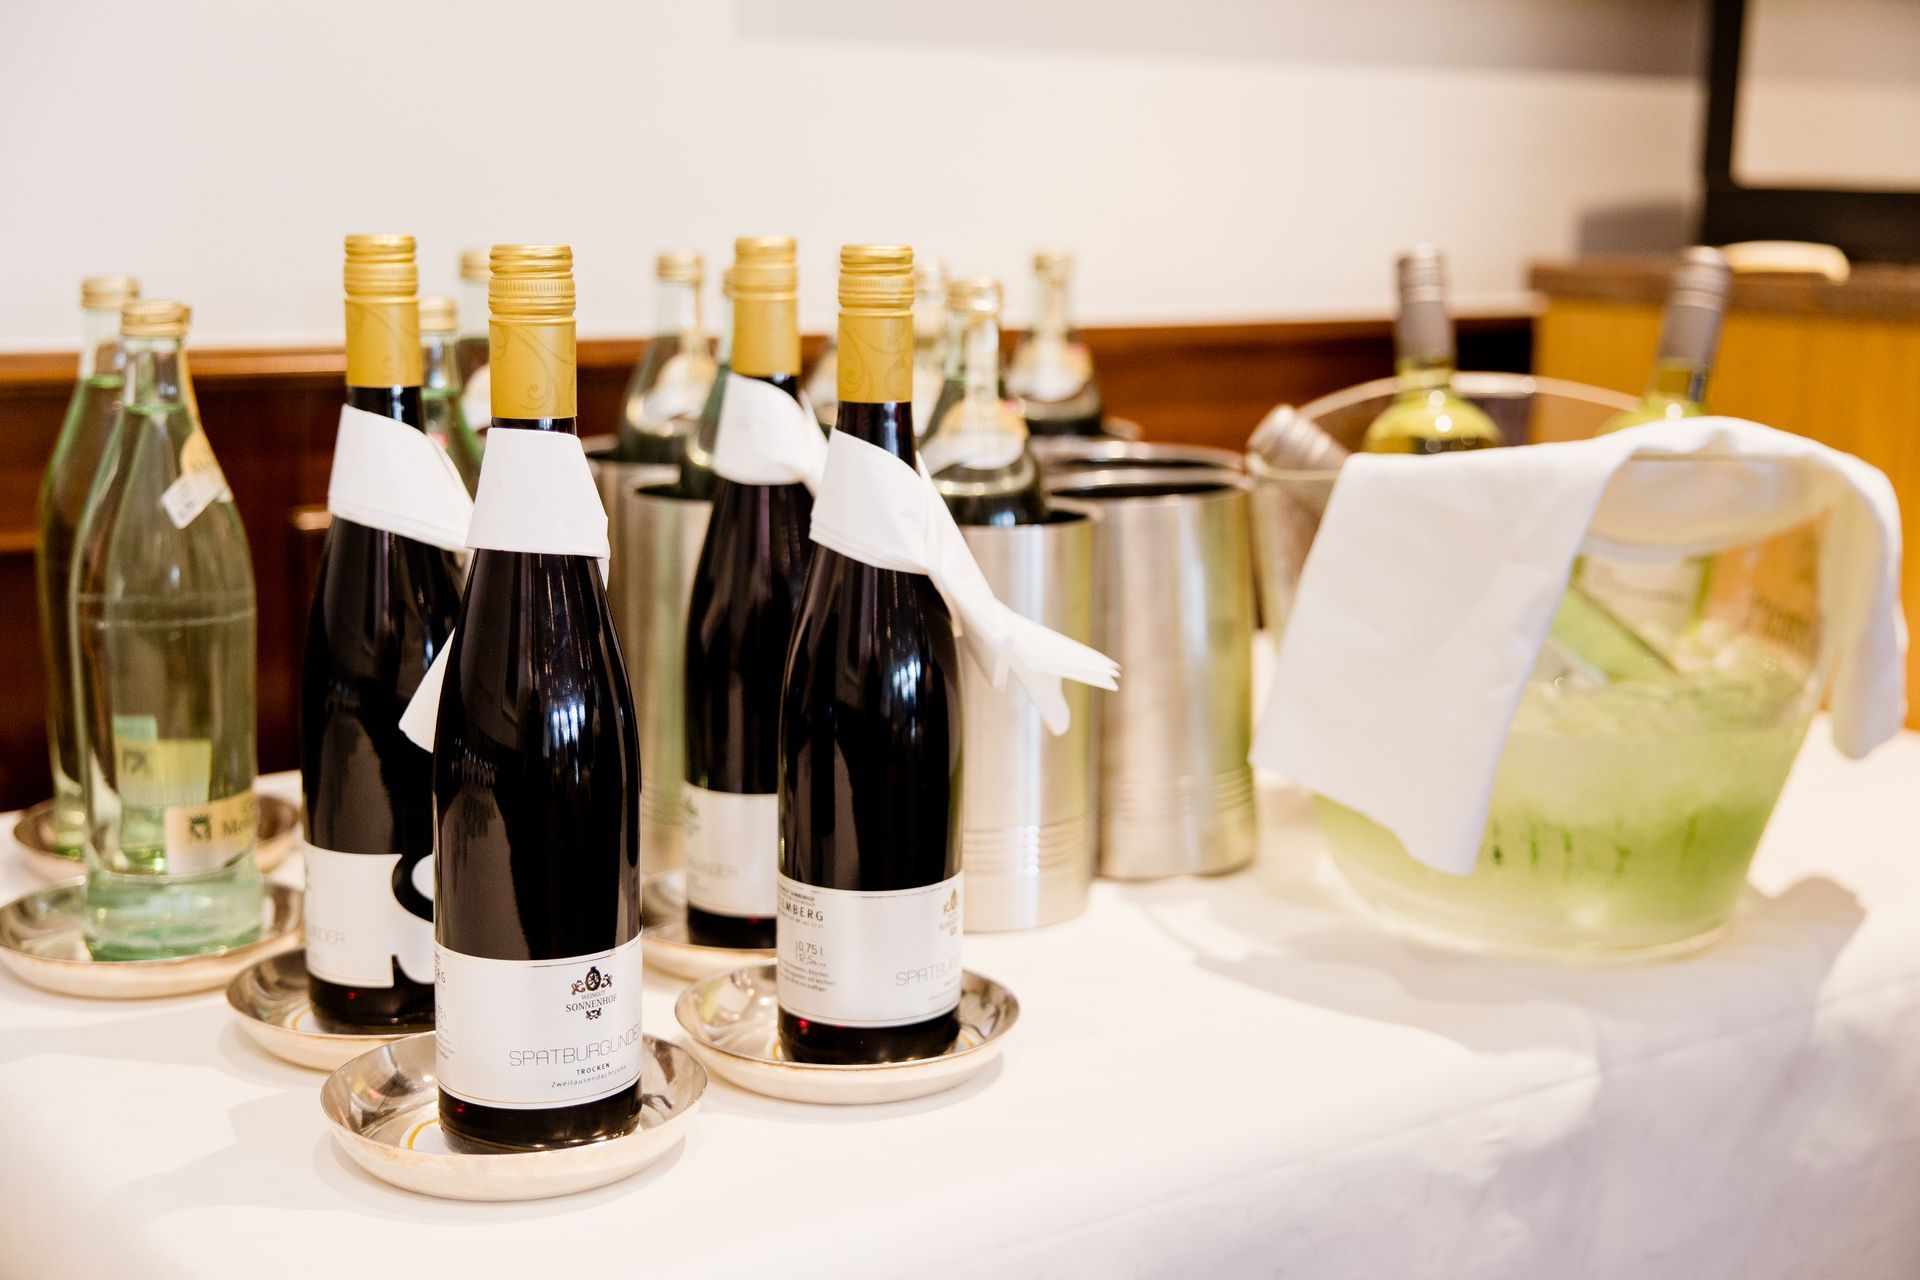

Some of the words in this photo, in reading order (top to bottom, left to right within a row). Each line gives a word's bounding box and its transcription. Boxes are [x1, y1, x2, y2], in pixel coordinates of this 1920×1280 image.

[581, 989, 606, 1000] WEINGUT
[566, 993, 617, 1012] SONNENHOF
[576, 1062, 610, 1076] TROCKEN
